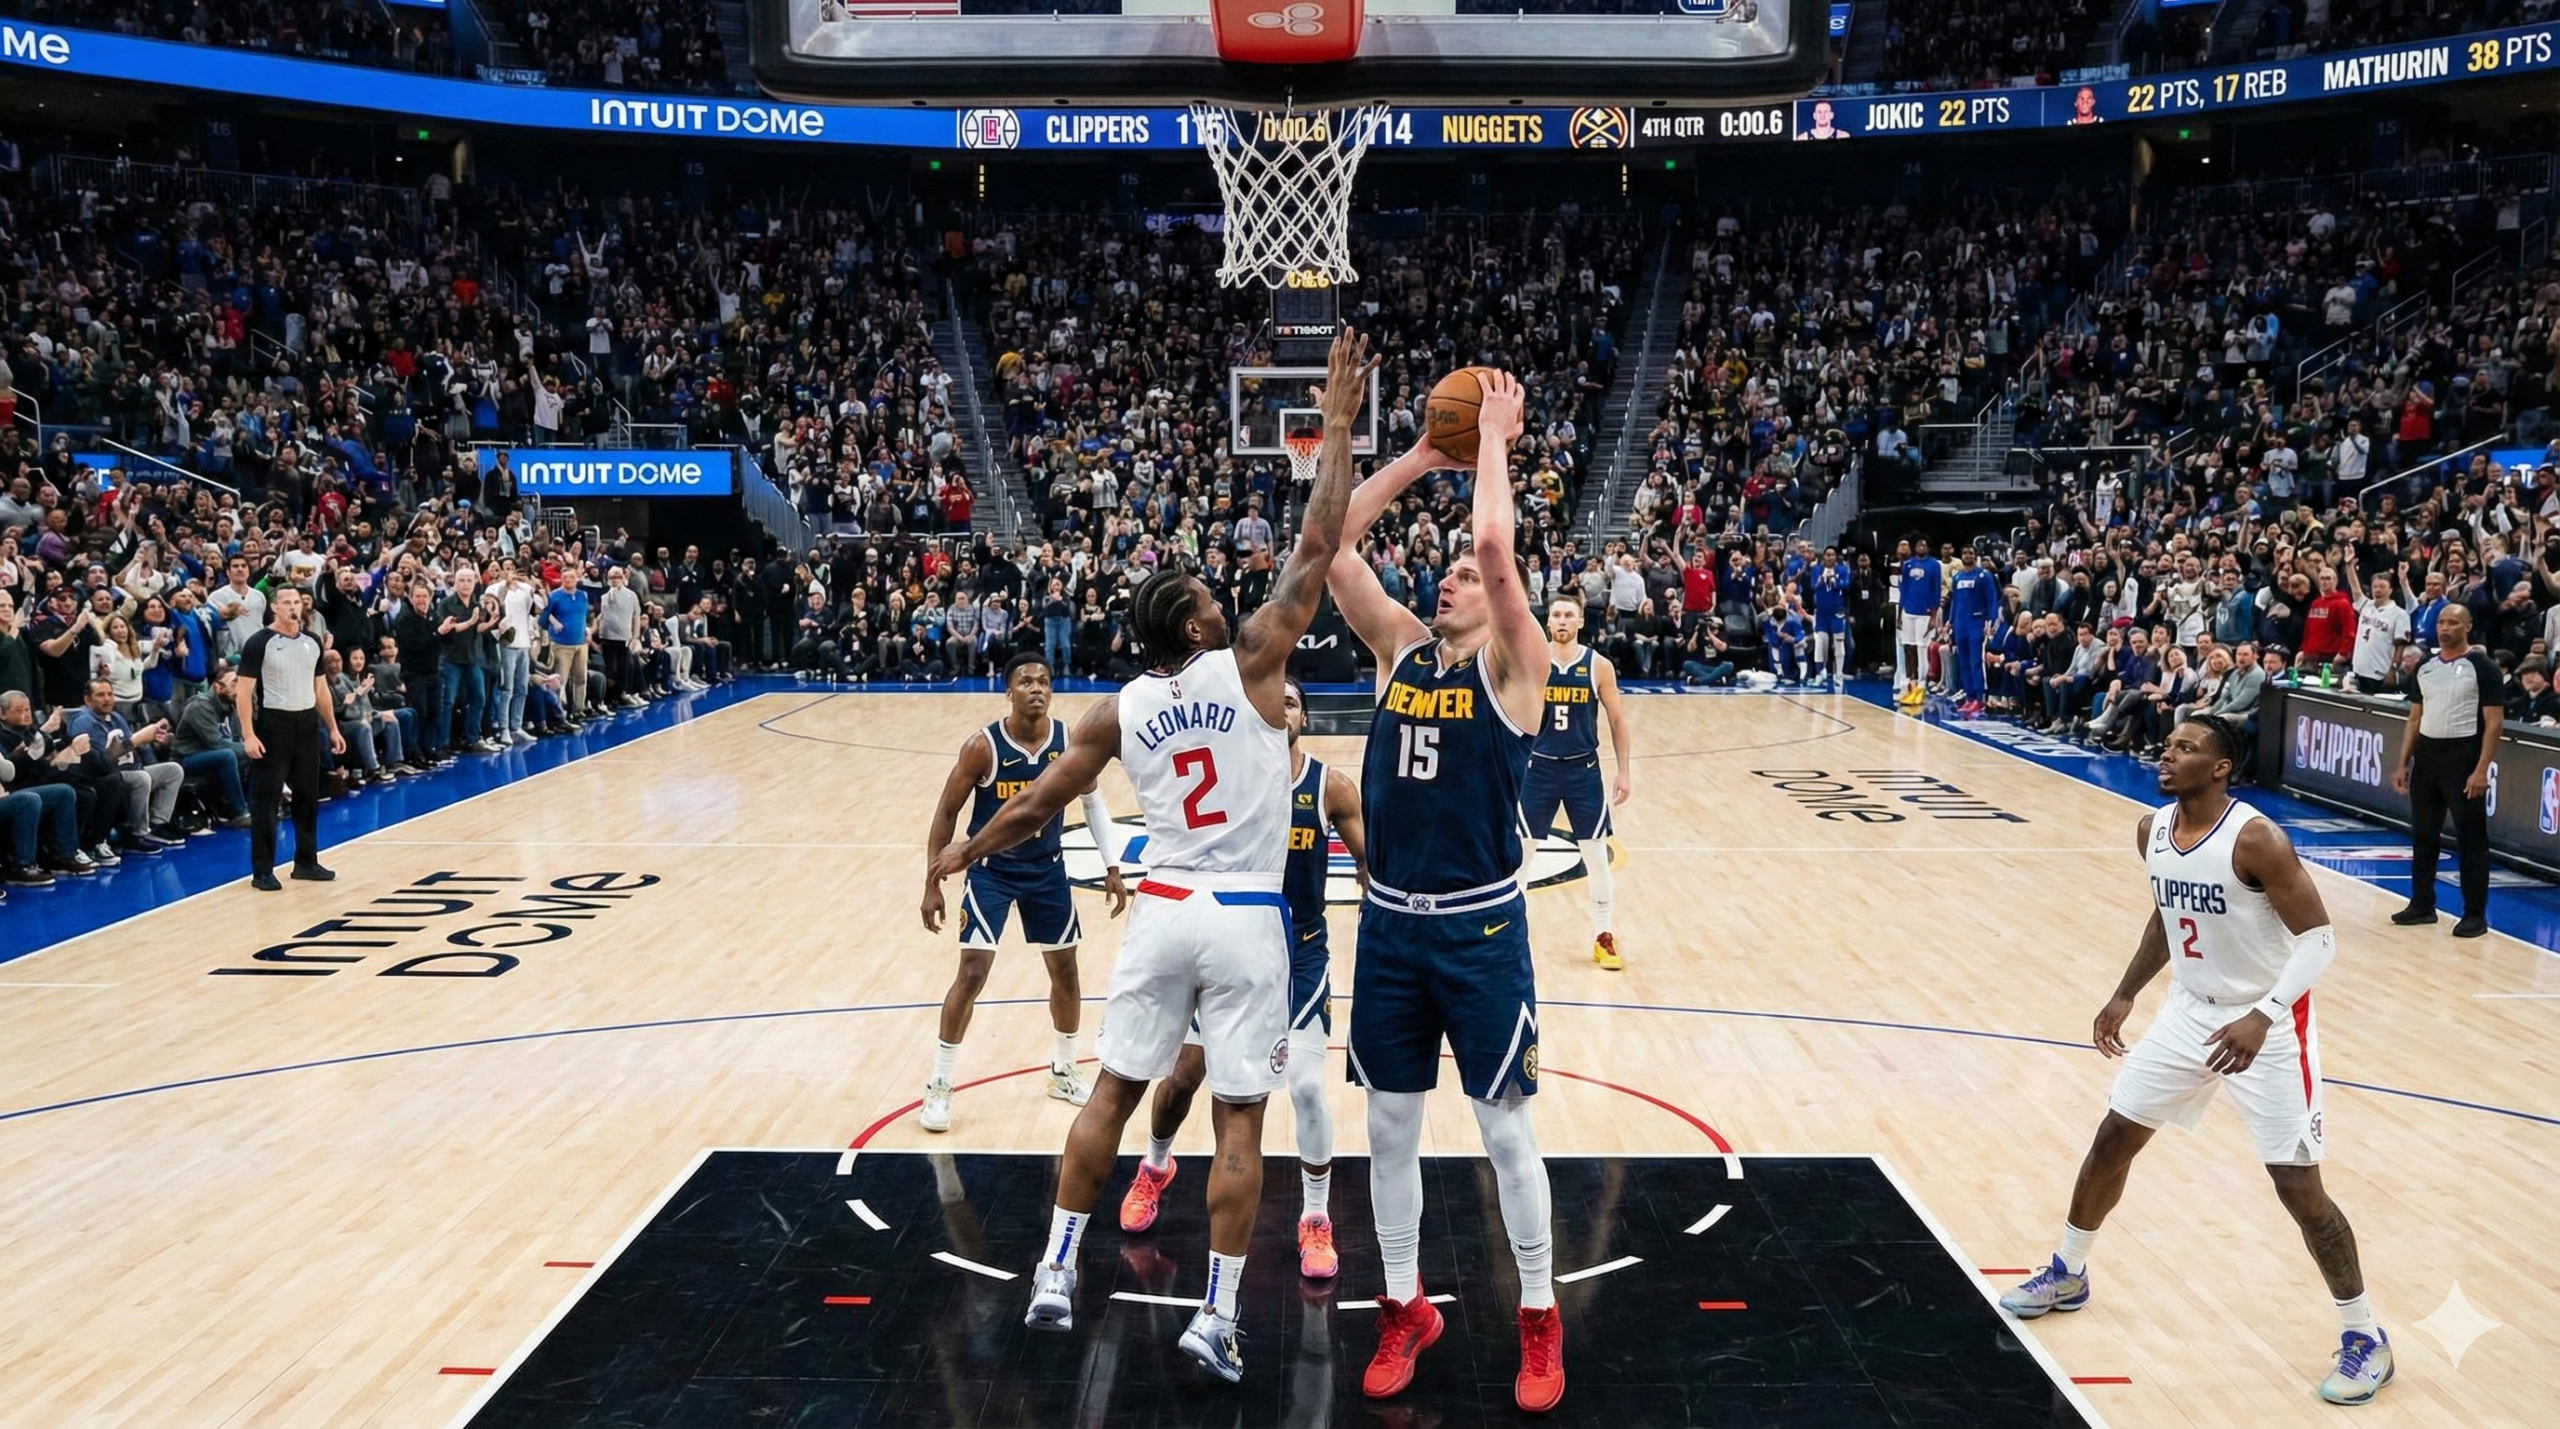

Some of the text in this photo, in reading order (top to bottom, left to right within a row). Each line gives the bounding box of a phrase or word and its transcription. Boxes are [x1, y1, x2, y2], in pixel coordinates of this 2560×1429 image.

[2323, 32, 2552, 91] MATHURIN 38 PTS
[2127, 68, 2287, 113] 22 PTS, 17 REB
[591, 98, 825, 137] INTUIT DOME
[1046, 115, 1149, 144] CLIPPERS
[1442, 115, 1543, 143] NUGGETS
[1641, 110, 1783, 138] 4TH QTR 0:00.6
[1865, 97, 2011, 131] JOKIC 22 PTS
[521, 462, 702, 485] INTUIT DOME
[1385, 681, 1474, 720] DENVER
[1545, 686, 1590, 703] ENVER
[1135, 701, 1237, 751] LEONARD
[1554, 705, 1570, 731] 5
[1397, 723, 1441, 781] 15
[2309, 718, 2384, 787] CLIPPERS
[1171, 744, 1229, 831] 2
[1847, 769, 2031, 823] INTUIT
[207, 870, 528, 977] INTUIT
[375, 870, 661, 978] DOME
[2179, 917, 2204, 960] 2
